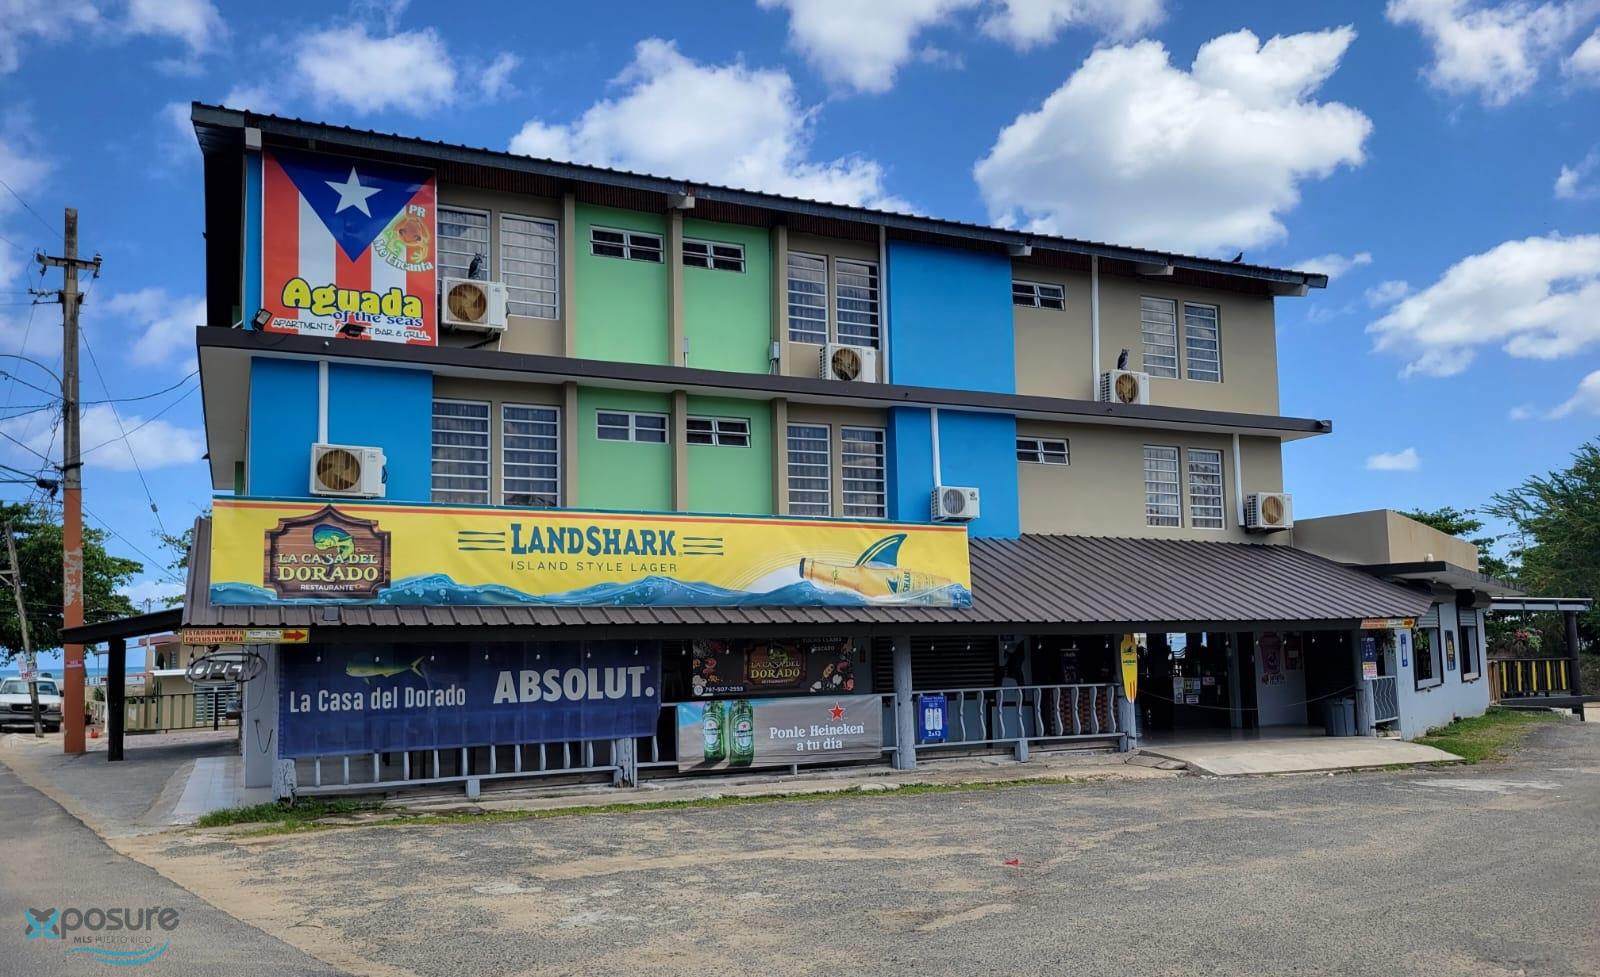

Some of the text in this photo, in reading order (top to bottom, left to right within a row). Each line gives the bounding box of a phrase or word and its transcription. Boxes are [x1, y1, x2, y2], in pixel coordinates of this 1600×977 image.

[409, 204, 426, 218] PR
[282, 277, 423, 318] Aguada
[333, 311, 423, 326] of the seas
[272, 319, 334, 331] APARTMENTS
[375, 328, 394, 336] BAR
[403, 331, 430, 340] GRILL
[278, 553, 378, 565] LA CASA DEL
[278, 566, 379, 582] DORADO
[511, 561, 677, 573] ISLAND STYLE LAGER
[751, 668, 800, 679] DORADO
[493, 666, 655, 704] ABSOLUT.
[290, 685, 466, 713] La Casa del Dorado
[769, 723, 864, 739] Ponle Heineken
[796, 737, 843, 751] a tu día
